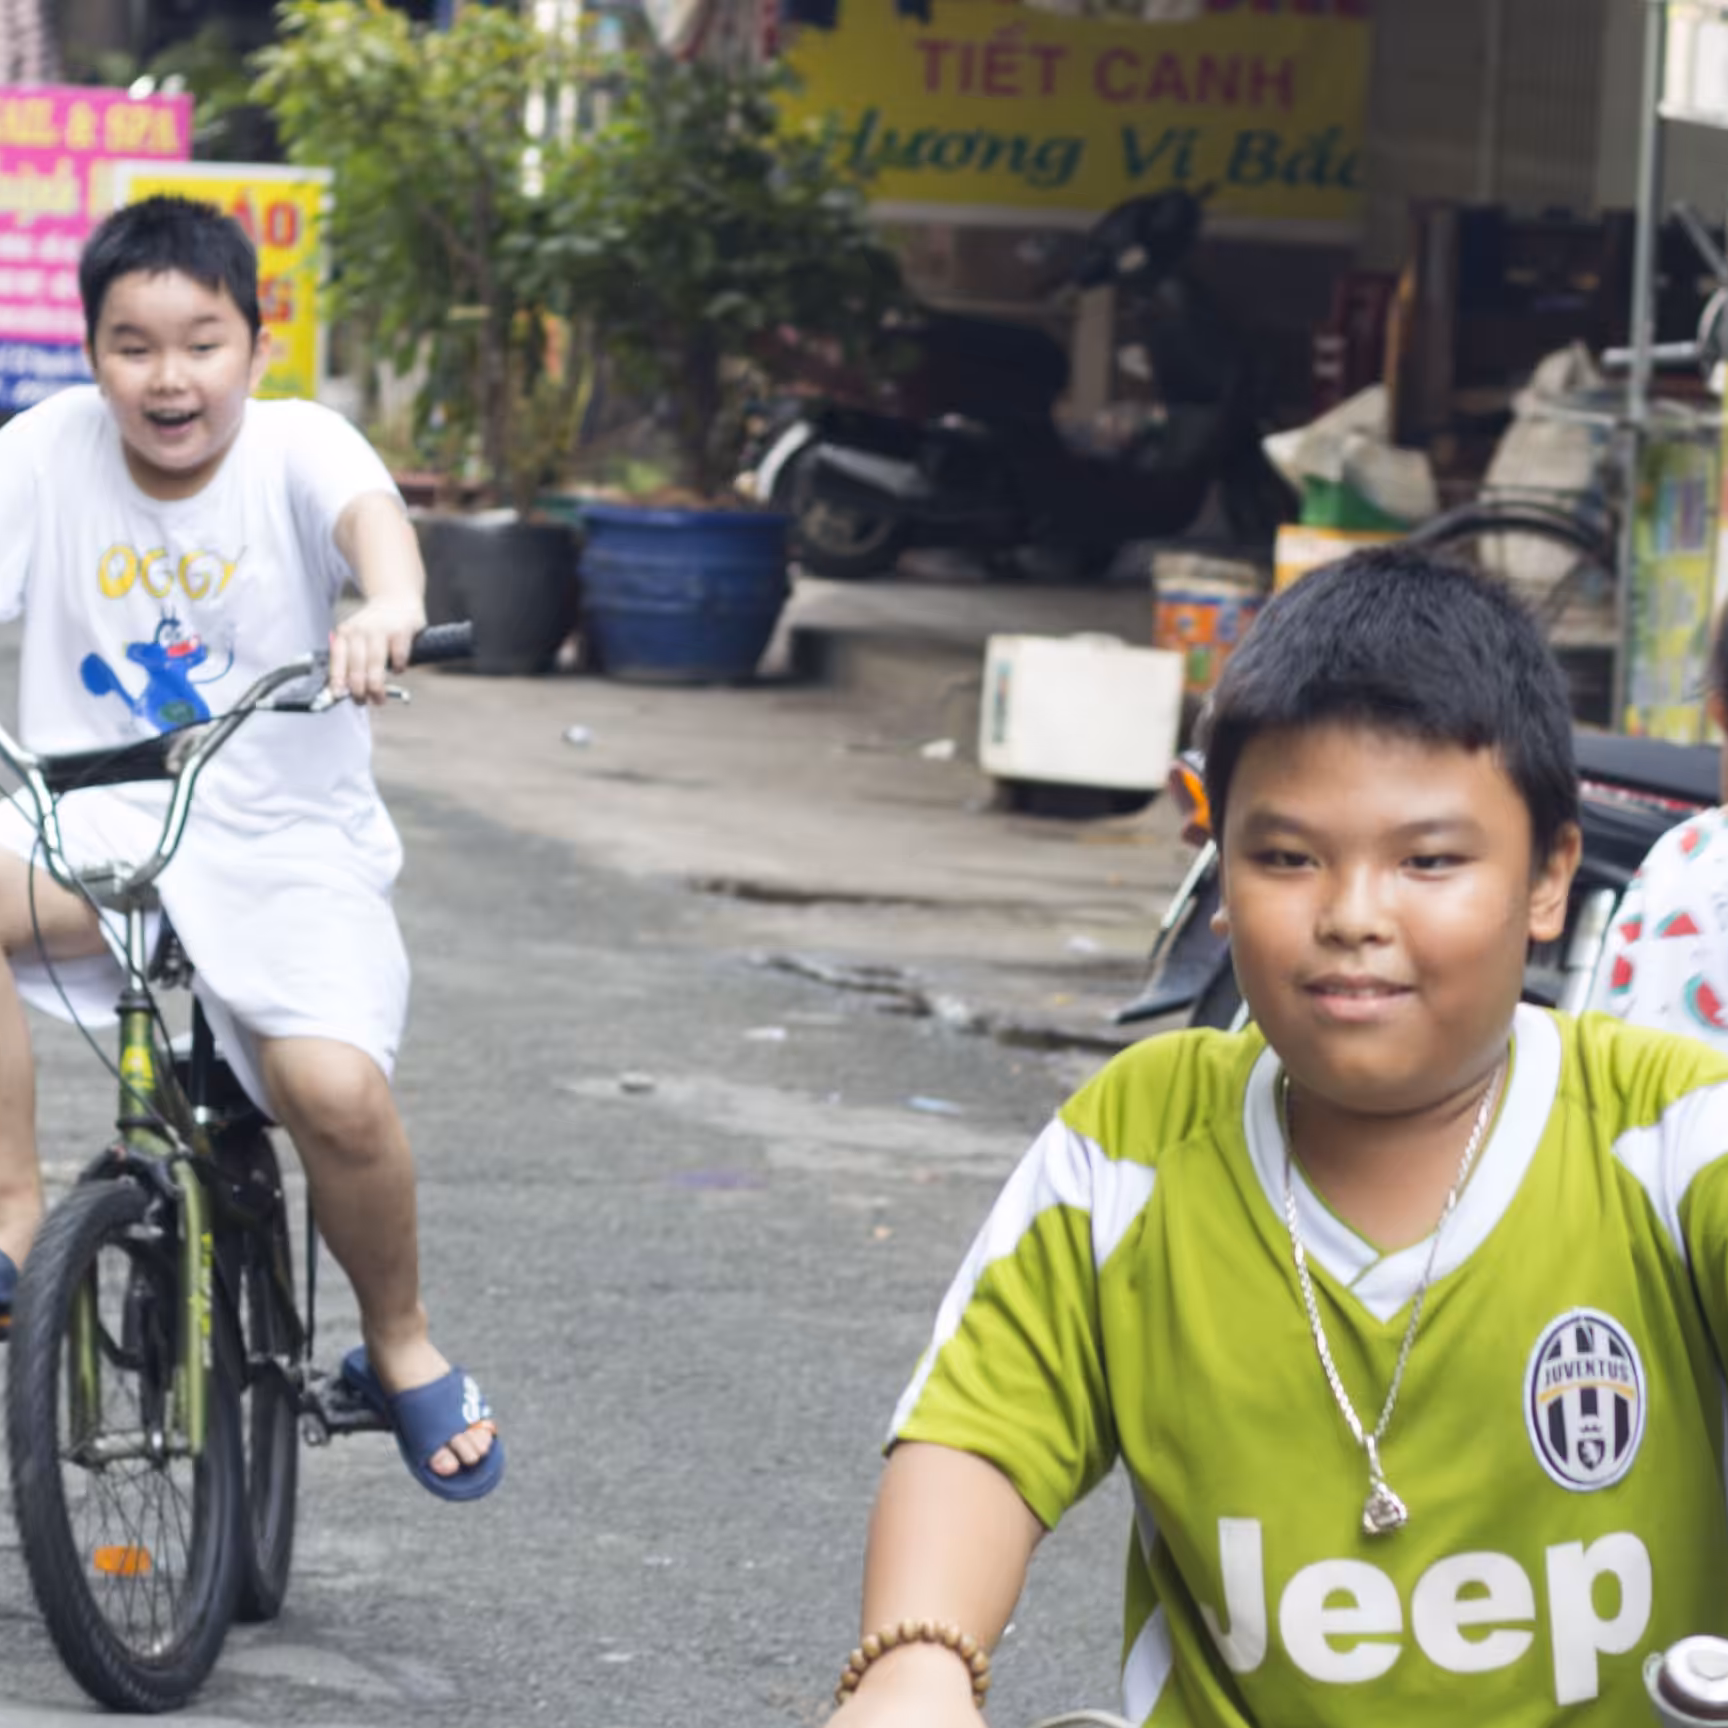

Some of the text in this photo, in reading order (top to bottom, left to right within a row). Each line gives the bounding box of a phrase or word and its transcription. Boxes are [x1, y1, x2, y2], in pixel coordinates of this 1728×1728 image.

[915, 22, 1296, 113] TIẾT CANH
[97, 544, 244, 601] OGGY
[1545, 1359, 1629, 1386] JUVENTUS
[1199, 1516, 1653, 1706] Jeep
